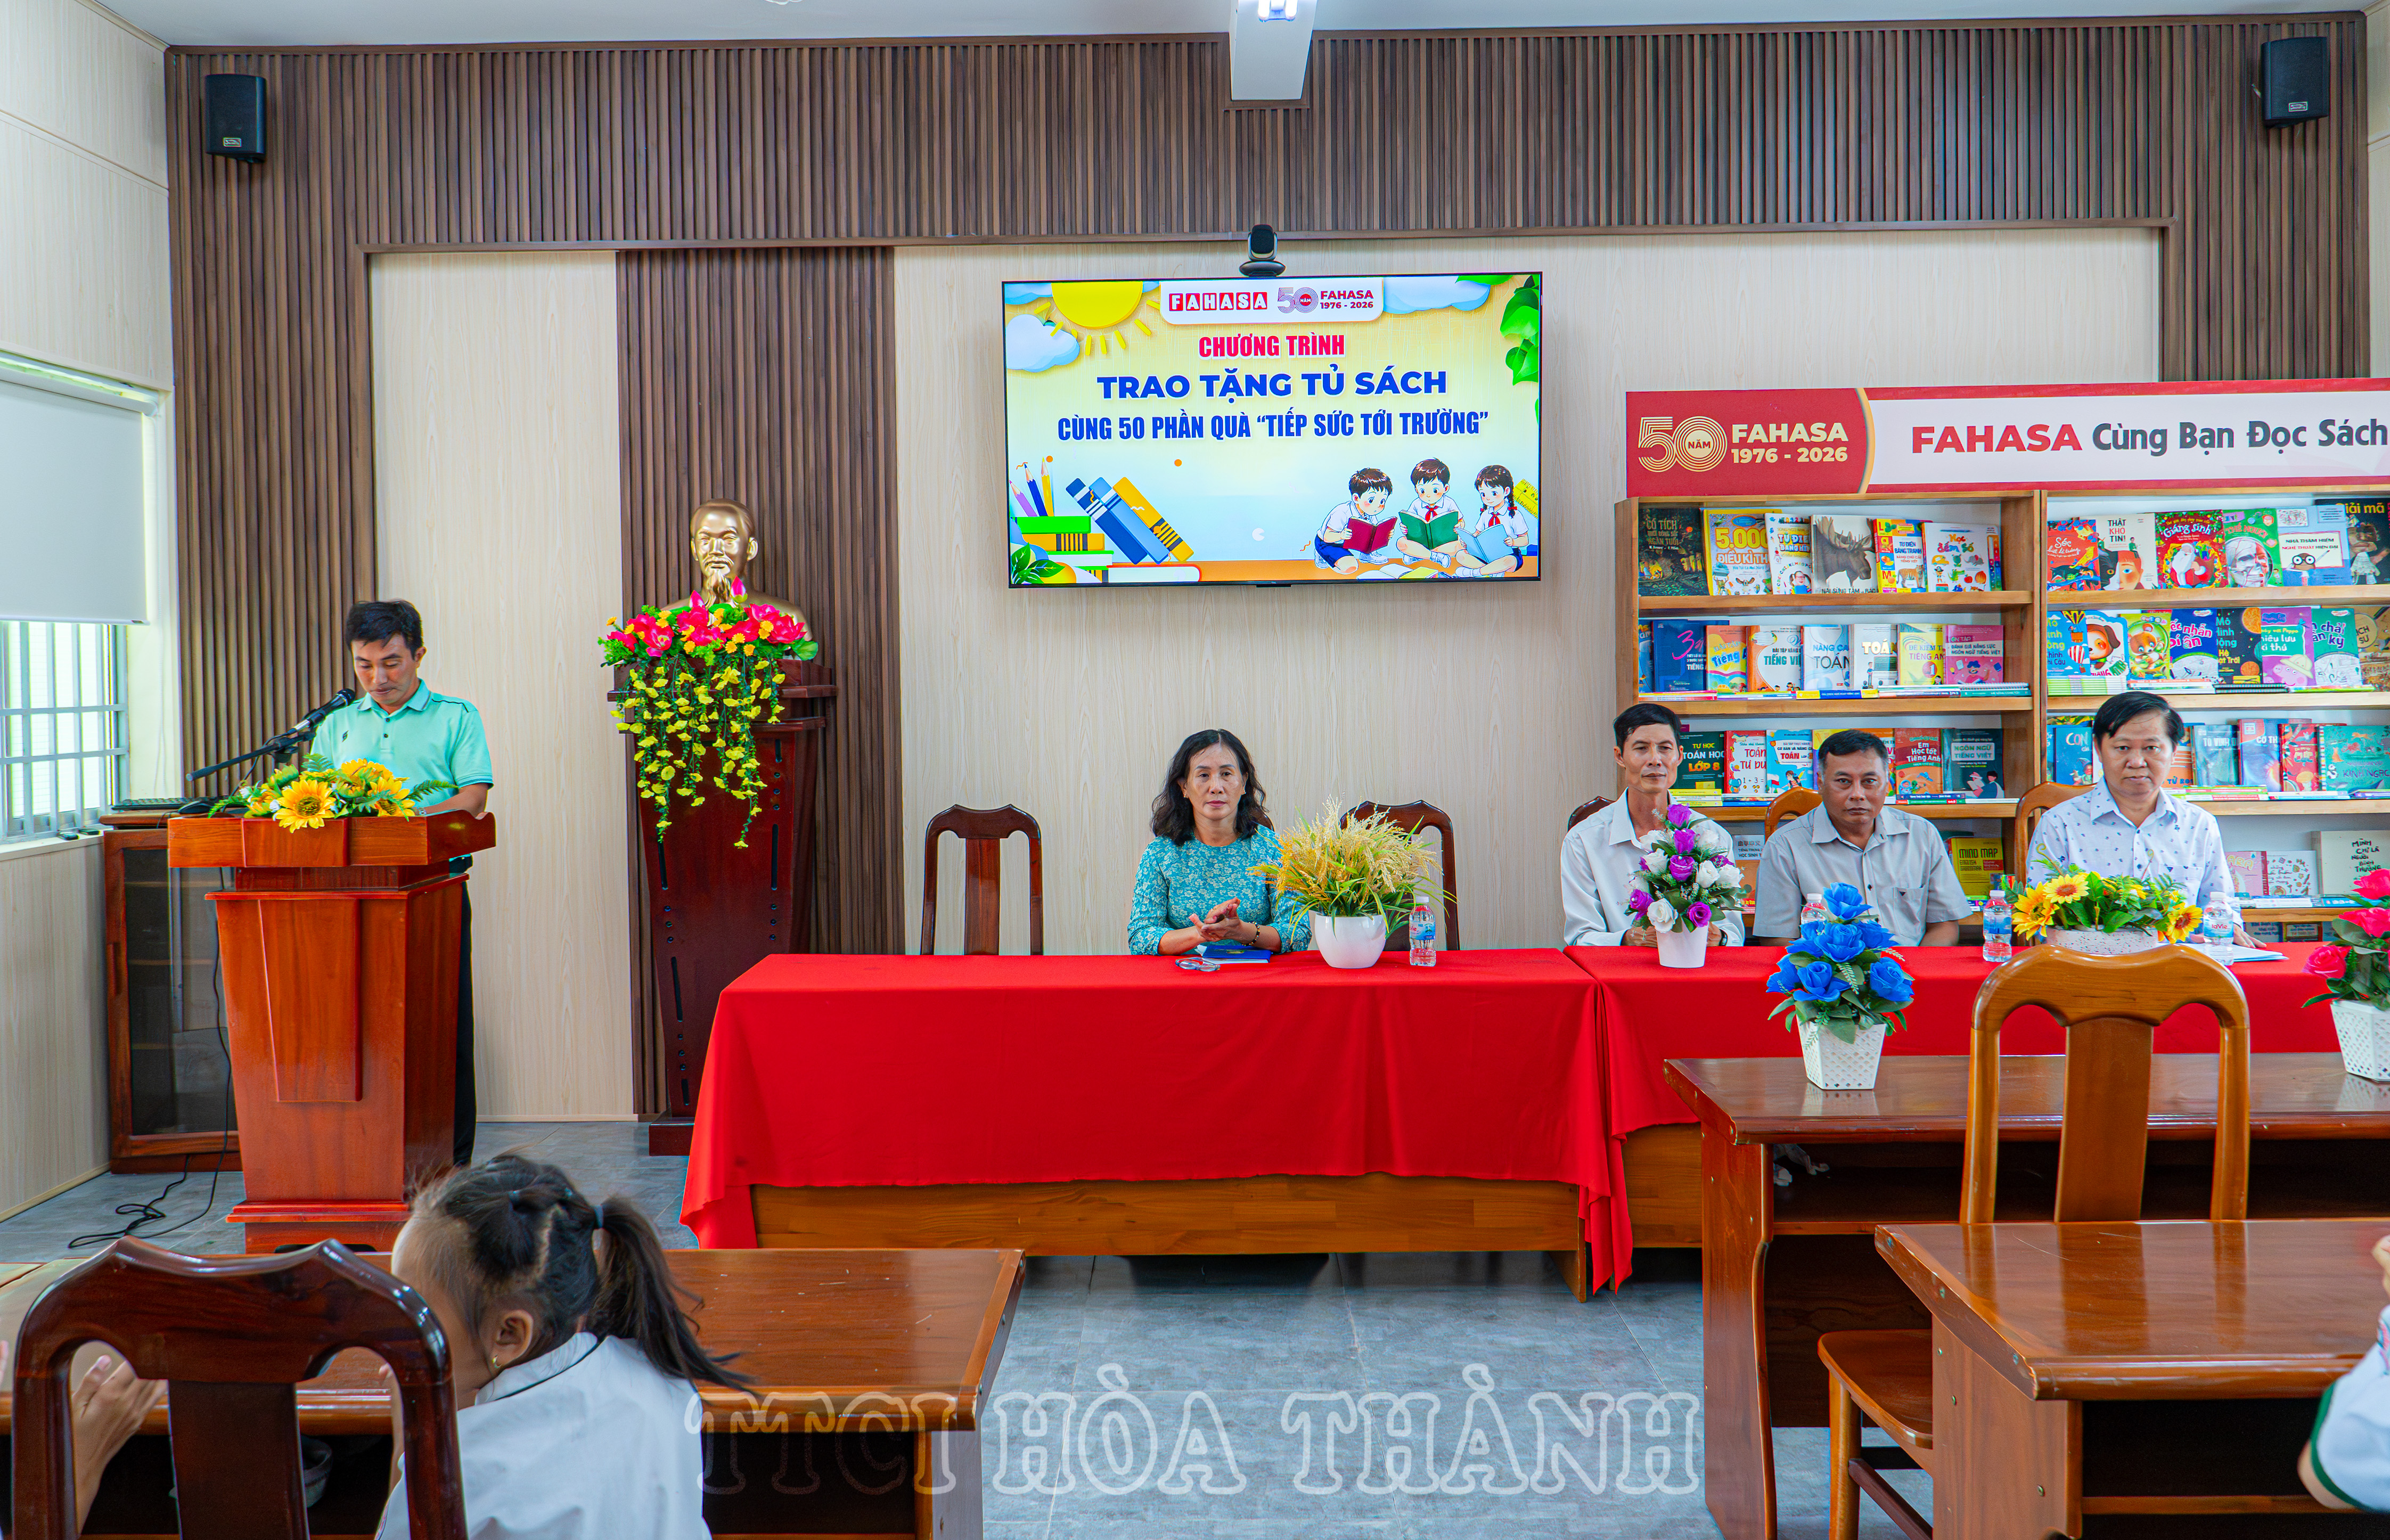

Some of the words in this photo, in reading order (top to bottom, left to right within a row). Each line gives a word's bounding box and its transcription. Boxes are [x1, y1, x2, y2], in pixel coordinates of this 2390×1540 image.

[1278, 287, 1319, 313] 50
[1321, 290, 1374, 299] FAHASA
[1169, 292, 1267, 312] FAHASA
[1199, 333, 1279, 357] CHƯƠNG
[1286, 332, 1345, 356] TRÌNH
[1096, 375, 1190, 399] TRAO
[1199, 368, 1292, 404] TẶNG
[1302, 364, 1344, 396] TỦ
[1355, 365, 1446, 395] SÁCH
[1058, 414, 1112, 440] CÙNG
[1119, 417, 1144, 439] 50
[1152, 409, 1204, 439] PHẦN
[1211, 412, 1251, 440] QUÀ
[1257, 407, 1307, 437] “TIẾP
[1314, 410, 1354, 437] SỨC
[1361, 409, 1392, 436] TỚI
[1399, 408, 1488, 435] TRƯỜNG”
[1732, 422, 1848, 443] FAHASA
[1912, 424, 2082, 453] FAHASA
[2092, 423, 2167, 456] Cùng
[2179, 422, 2234, 455] Bạn
[2247, 420, 2306, 454] Đọc
[2318, 418, 2388, 446] Sách
[1638, 416, 1727, 472] 50
[1687, 439, 1711, 449] NĂM
[1732, 448, 1778, 463] 1976
[1797, 447, 1847, 462] 2026
[2336, 502, 2361, 513] iải
[2363, 502, 2385, 513] mã
[2107, 518, 2126, 527] THẬT
[2109, 526, 2125, 535] KHÓ
[2164, 524, 2191, 538] Giáng
[2055, 537, 2072, 548] Sóc
[1717, 549, 1742, 564] ĐIỀU
[2183, 624, 2212, 638] nhẫn
[2216, 638, 2237, 649] ộng
[1711, 650, 1740, 667] Tiếng
[1764, 653, 1787, 665] TIẾNG
[1814, 653, 1851, 669] TOÁN
[1929, 664, 1935, 675] 1
[1683, 750, 1706, 759] TOÁN
[1688, 760, 1711, 772] LỚP
[1712, 762, 1720, 771] 8
[2352, 838, 2371, 847] MÌNH
[1959, 848, 1978, 858] MIND
[1980, 848, 1998, 858] MAP
